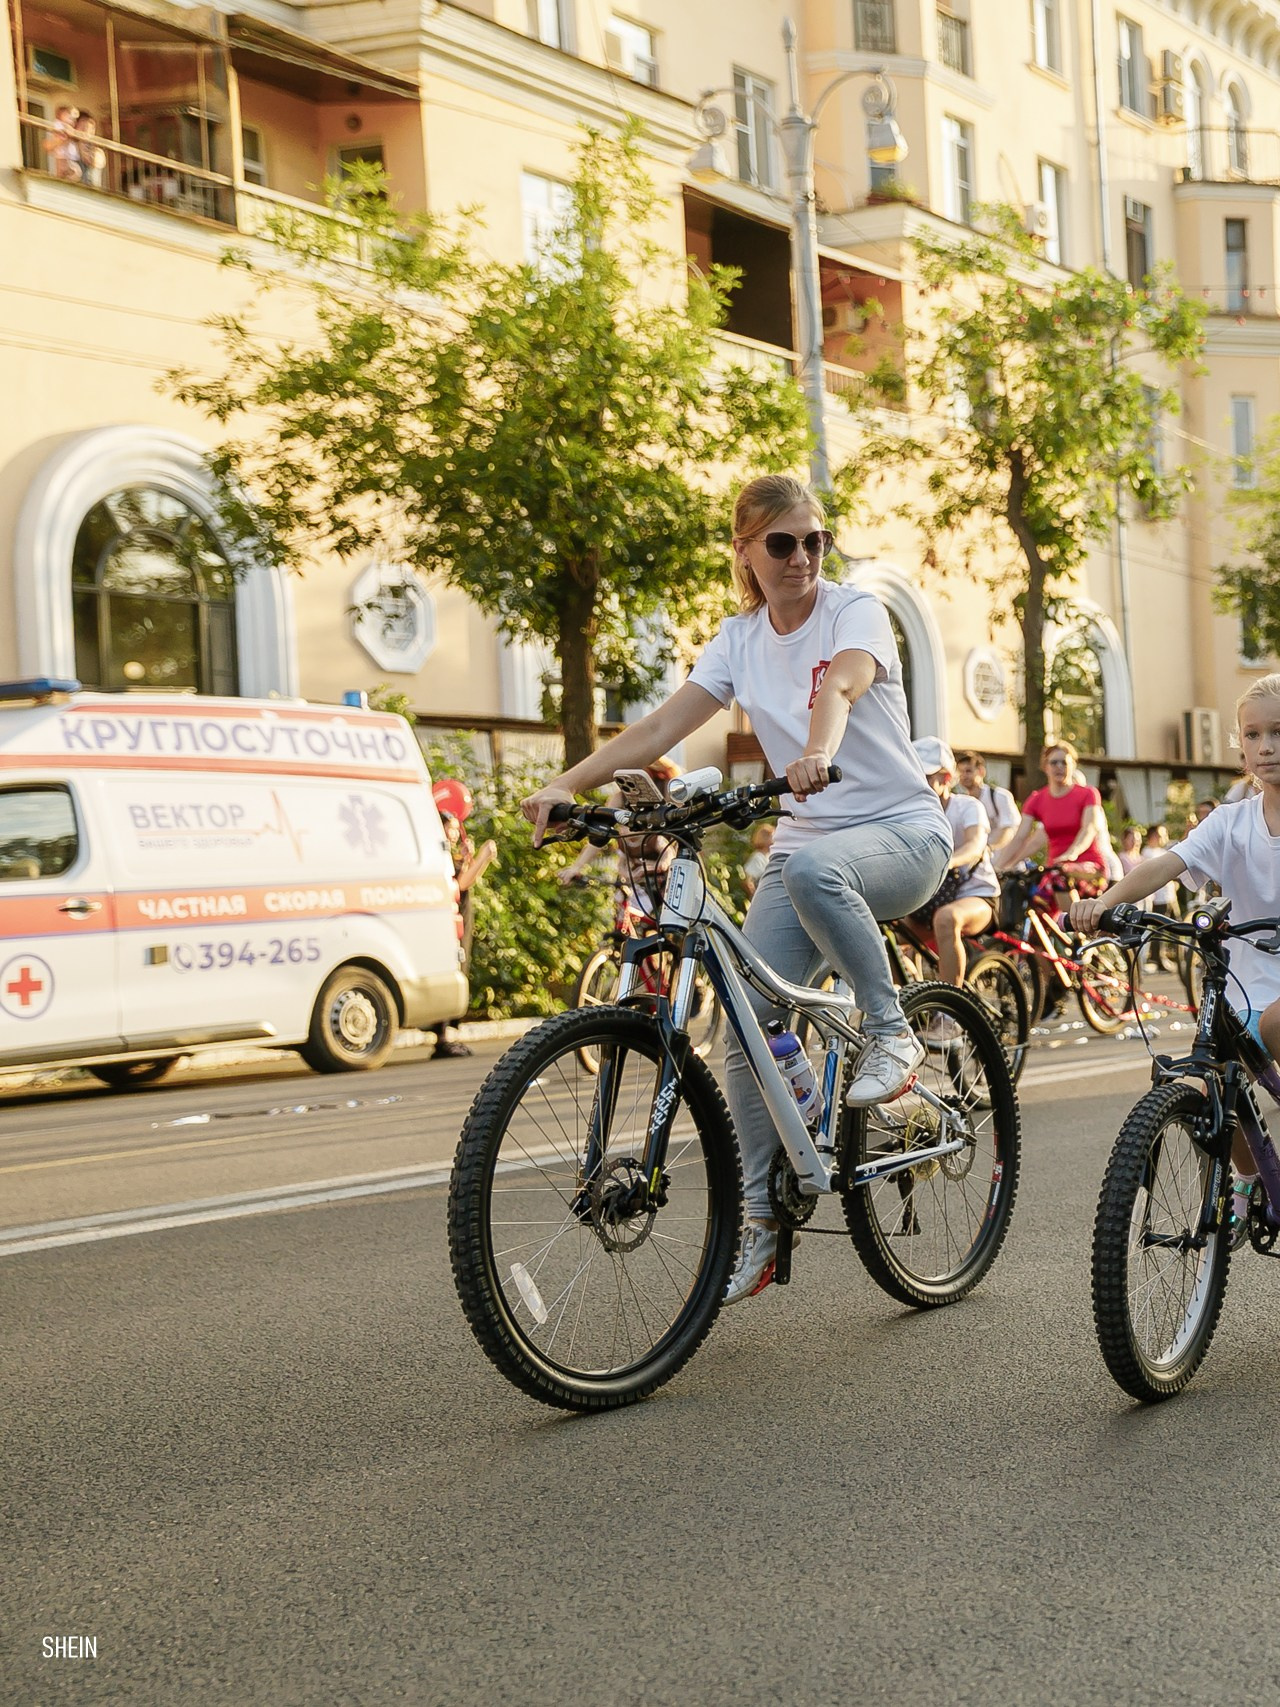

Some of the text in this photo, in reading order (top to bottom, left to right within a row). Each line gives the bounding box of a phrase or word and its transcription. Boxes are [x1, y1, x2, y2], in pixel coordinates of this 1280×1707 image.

[59, 718, 407, 762] КРУГЛОСУТОЧНО
[128, 803, 246, 829] ВЕКТОР
[137, 894, 247, 920] ЧАСТНАЯ
[263, 888, 346, 912] СКОРАЯ
[199, 937, 321, 969] 394-265
[864, 1165, 877, 1177] 3.0
